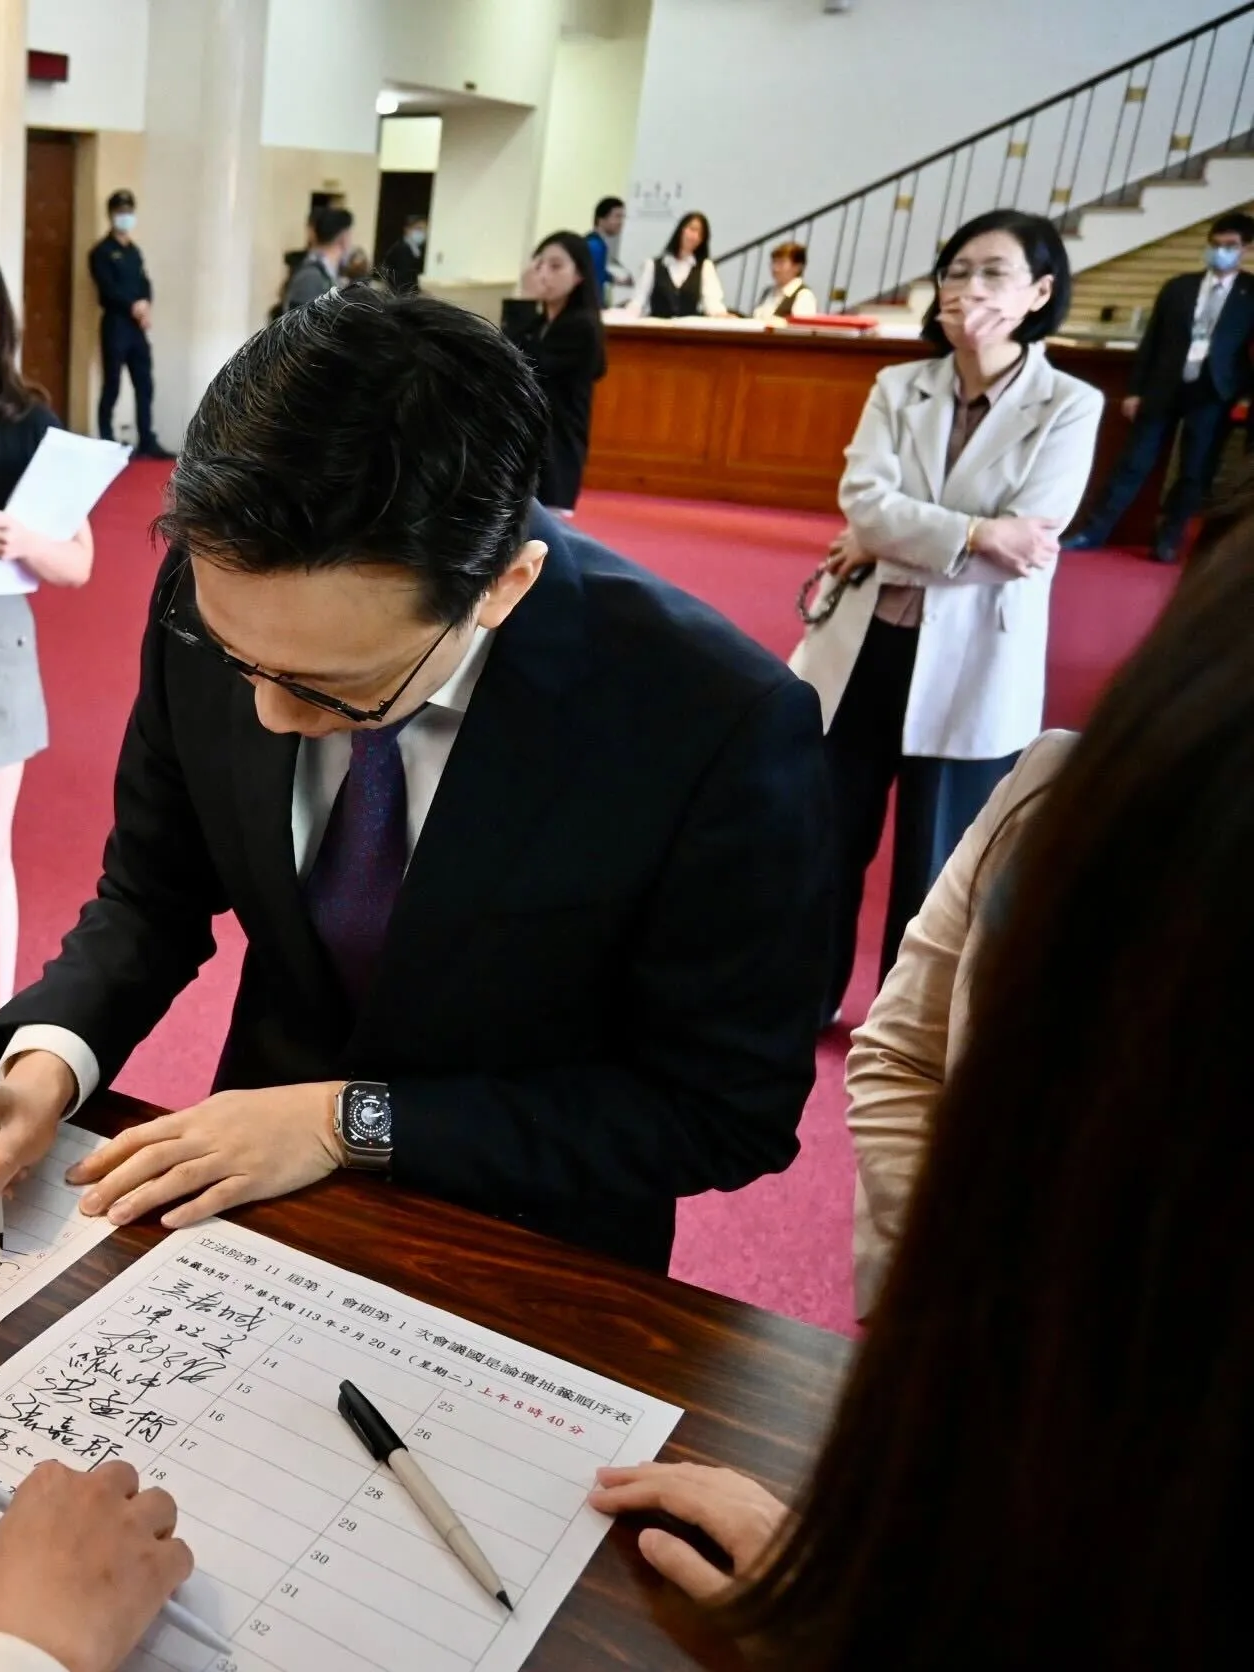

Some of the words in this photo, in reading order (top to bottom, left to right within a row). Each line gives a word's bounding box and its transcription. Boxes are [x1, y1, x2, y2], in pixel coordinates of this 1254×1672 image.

[199, 1238, 261, 1266] 立法院第
[263, 1264, 281, 1276] 11
[325, 1290, 335, 1299] 1
[398, 1321, 407, 1330] 1
[123, 1295, 135, 1304] 2
[96, 1318, 107, 1326] 3
[287, 1333, 304, 1345] 13
[262, 1357, 279, 1369] 14
[36, 1365, 48, 1375] 5
[236, 1382, 253, 1394] 15
[4, 1393, 16, 1402] 6
[437, 1400, 455, 1413] 25
[207, 1409, 226, 1422] 16
[413, 1428, 433, 1441] 26
[179, 1437, 199, 1451] 17
[149, 1467, 167, 1481] 18
[364, 1486, 384, 1500] 28
[337, 1517, 358, 1532] 29
[309, 1550, 330, 1565] 30
[280, 1583, 299, 1598] 31
[249, 1619, 271, 1637] 32
